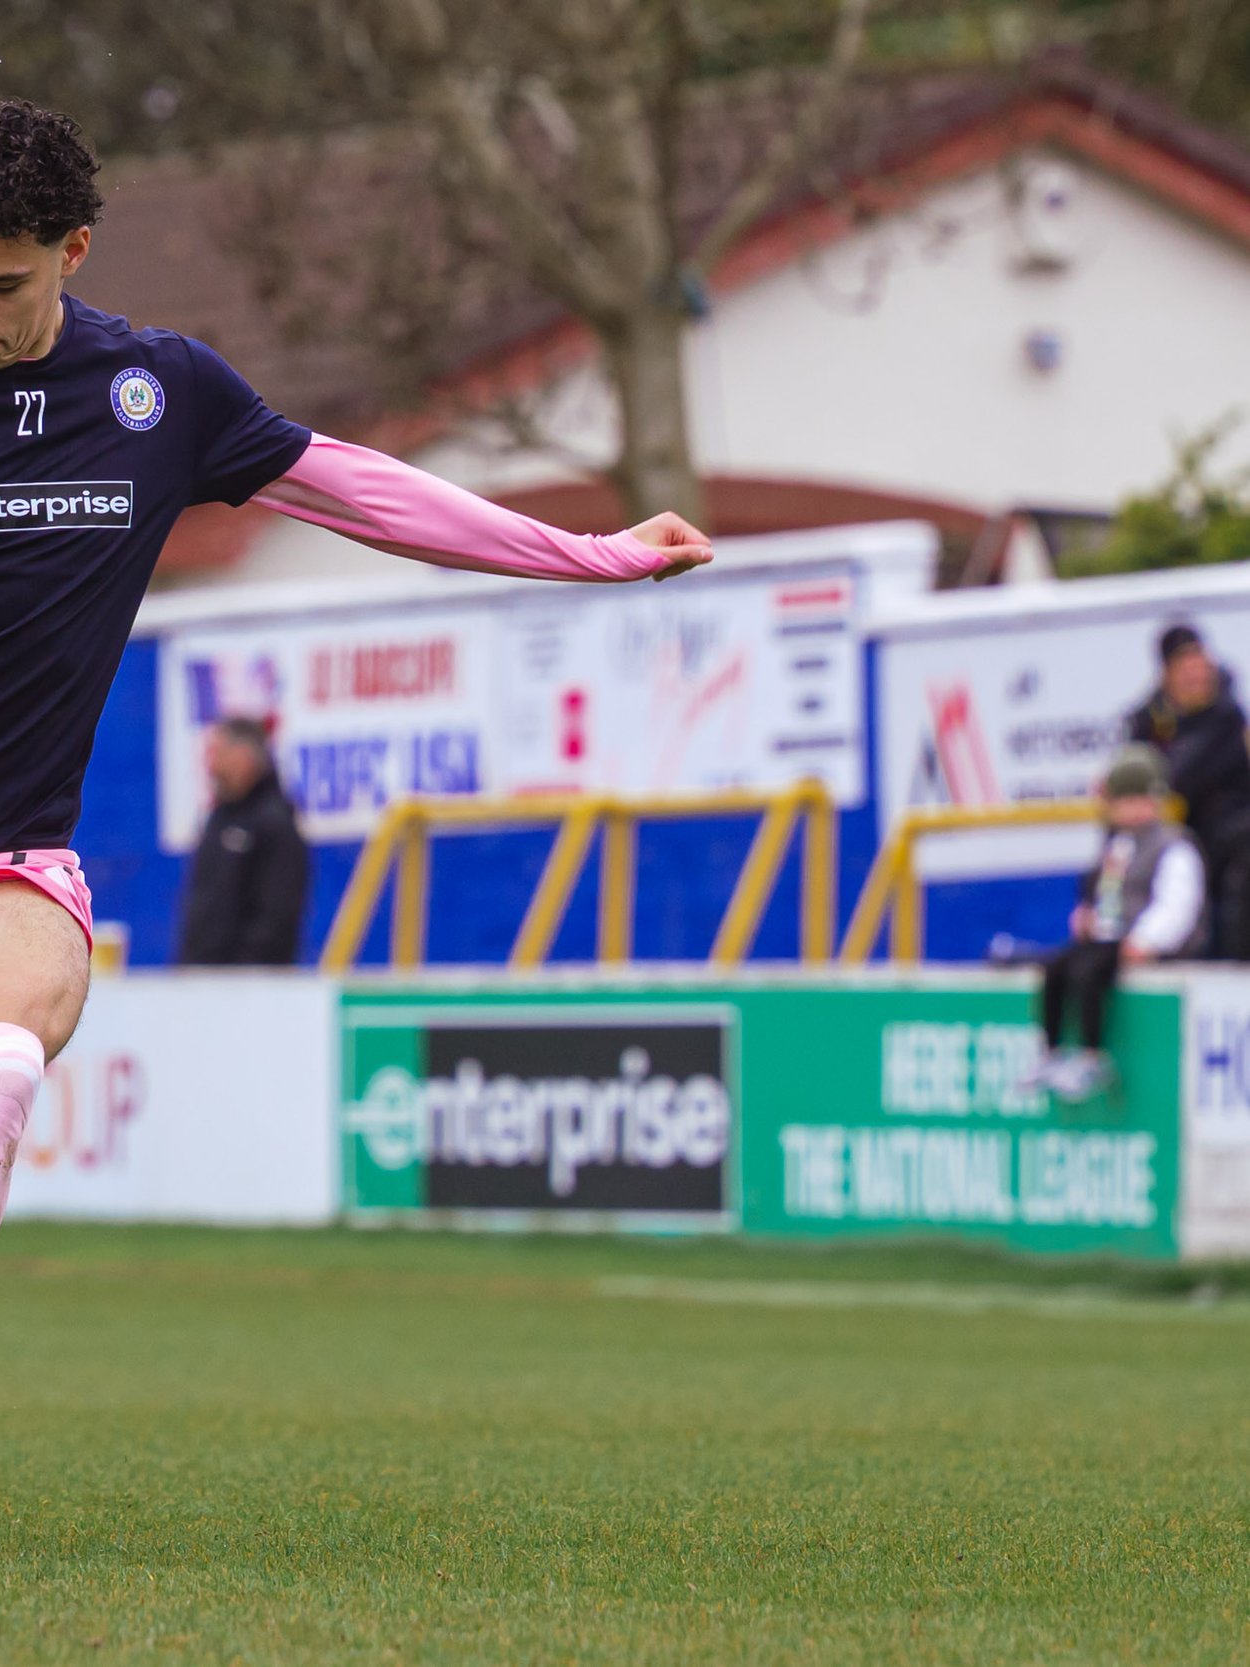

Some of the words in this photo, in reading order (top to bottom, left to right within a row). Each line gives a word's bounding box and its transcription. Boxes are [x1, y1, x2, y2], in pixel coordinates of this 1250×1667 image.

[14, 390, 46, 436] 27
[113, 370, 134, 394] CURZON
[135, 370, 160, 393] ASHTON
[116, 406, 148, 429] FOOTBALL
[148, 405, 162, 424] CLUB
[881, 1021, 971, 1118] HERE
[348, 1046, 732, 1196] enterprise
[778, 1123, 847, 1220] THE
[850, 1125, 1014, 1224] NATIONAL
[1018, 1129, 1156, 1228] LEAGUE
